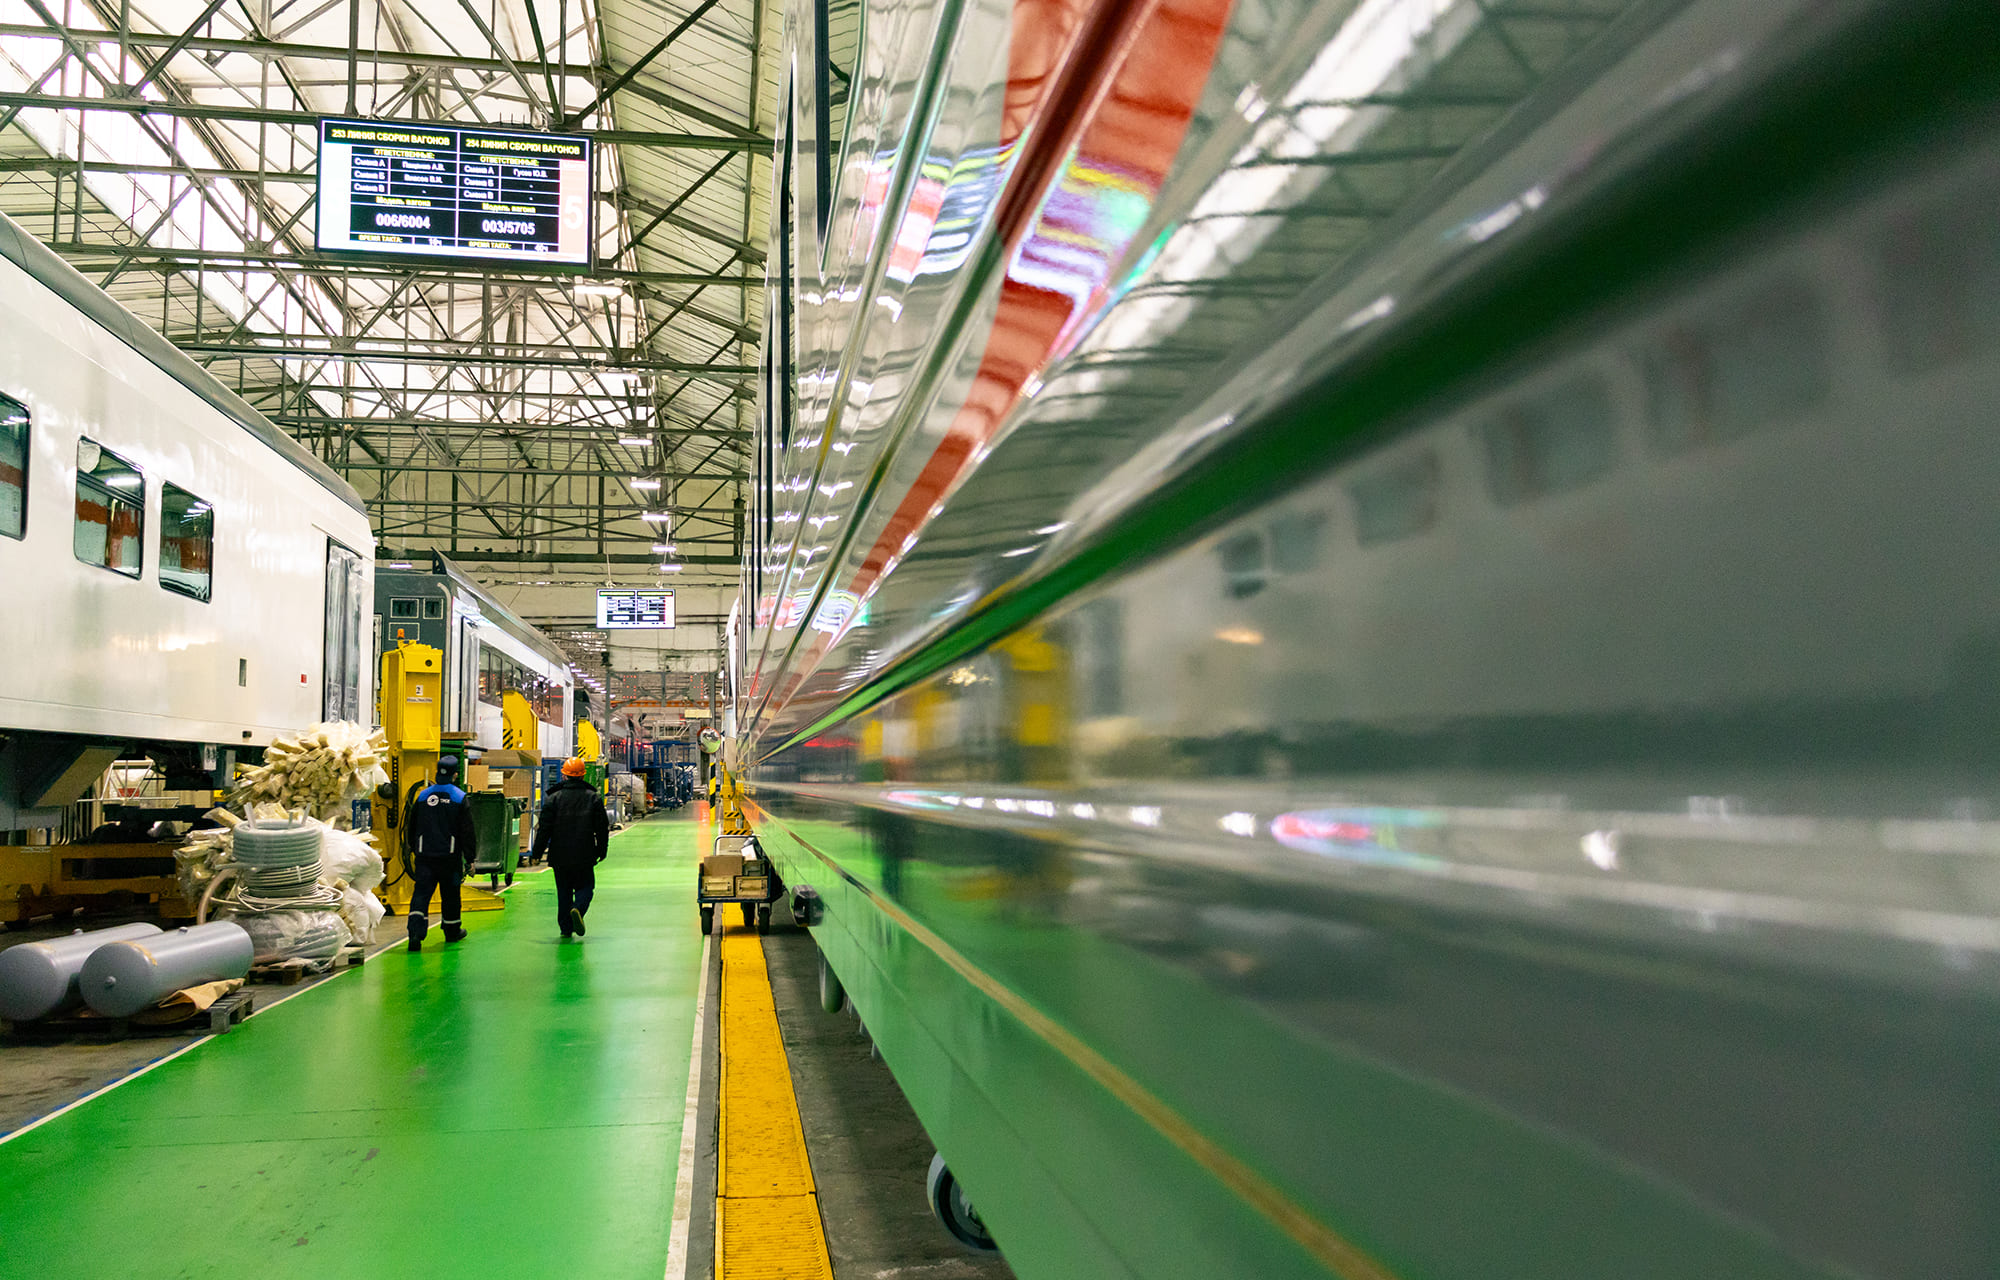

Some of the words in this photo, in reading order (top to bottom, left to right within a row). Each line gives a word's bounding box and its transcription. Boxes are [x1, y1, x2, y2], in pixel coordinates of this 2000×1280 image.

[347, 130, 376, 140] ЛИНИЯ
[377, 132, 410, 142] СБОРКИ
[411, 134, 450, 146] ВАГОНОВ
[466, 138, 480, 148] 254
[480, 140, 508, 150] ЛИНИЯ
[509, 141, 541, 152] СБОРКИ
[542, 144, 580, 155] ВАГОНОВ
[374, 148, 435, 159] ОТВЕТСТВЕННЫЕ:
[480, 155, 540, 166] ОТВЕТСТВЕННЫЕ:
[564, 194, 584, 230] 5
[376, 212, 431, 230] 006/6004
[482, 219, 536, 236] 003/5705
